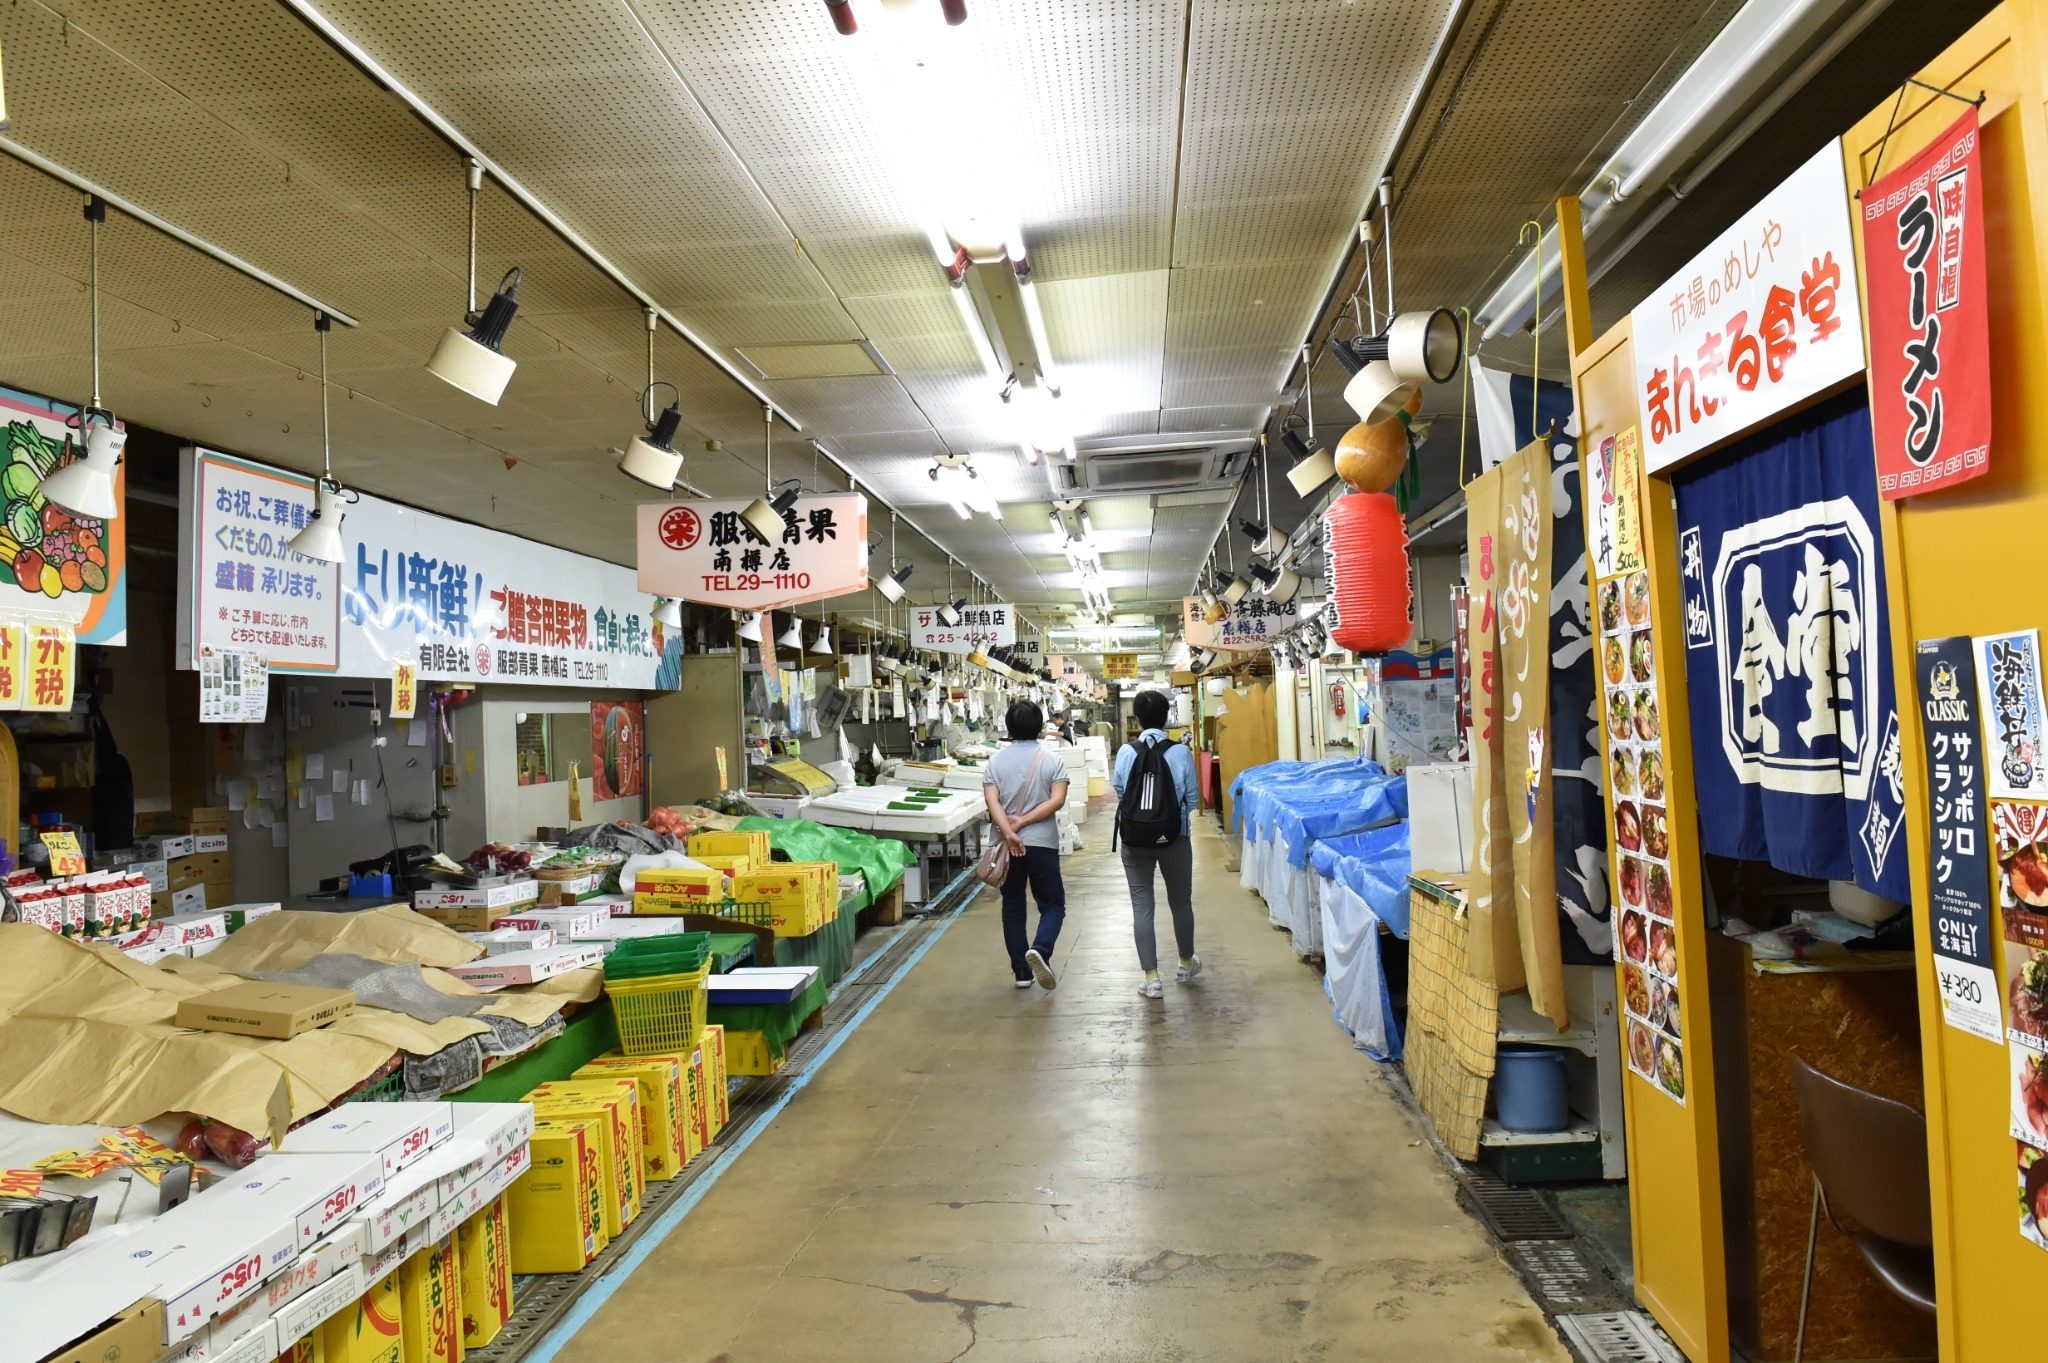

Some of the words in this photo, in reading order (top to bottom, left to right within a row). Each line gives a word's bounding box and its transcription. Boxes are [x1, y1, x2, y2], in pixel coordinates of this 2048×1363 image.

[1940, 180, 1965, 304] 味自慢
[1669, 219, 1783, 333] 市場のめしや
[1899, 192, 1943, 466] ラーメン
[661, 509, 699, 548] 栄
[709, 508, 837, 547] 服青果
[261, 566, 322, 601] 承ります。
[701, 573, 811, 592] TEL29-1110
[714, 548, 790, 573] 南樽店
[1615, 551, 1640, 572] 500円
[1685, 535, 1708, 640] 丼物
[231, 608, 309, 630] ご予算に応じ、市内
[231, 627, 328, 649] どちらでも配達いたします。
[36, 628, 65, 706] 外税
[419, 644, 470, 674] 有限会社
[476, 645, 490, 673] 栄
[497, 650, 538, 677] 服部青果
[541, 653, 568, 679] 南樽店
[573, 661, 609, 681] TEL29-1110
[1733, 543, 1861, 755] 食堂
[398, 665, 410, 711] 外税
[1926, 700, 1970, 721] CLASSIC
[1992, 641, 2028, 749] 海鮮丼
[1931, 731, 1954, 884] クラシック
[1952, 731, 1975, 856] サッポロ
[439, 894, 465, 904] いちご
[654, 883, 688, 893] AQ中央
[1938, 918, 1978, 950] ONLY
[1941, 971, 1982, 1004] ¥380
[667, 1081, 679, 1154] AQ中央
[687, 1066, 700, 1135] AQ中央
[400, 1127, 429, 1160] いちご
[619, 1121, 633, 1202] AQ中央
[321, 1184, 356, 1225] いちご
[586, 1147, 600, 1234] AQ中央
[216, 1254, 261, 1302] いちご
[445, 1251, 455, 1313] 有田みかん
[485, 1210, 499, 1308] AQ中央
[429, 1251, 447, 1357] AQ中央
